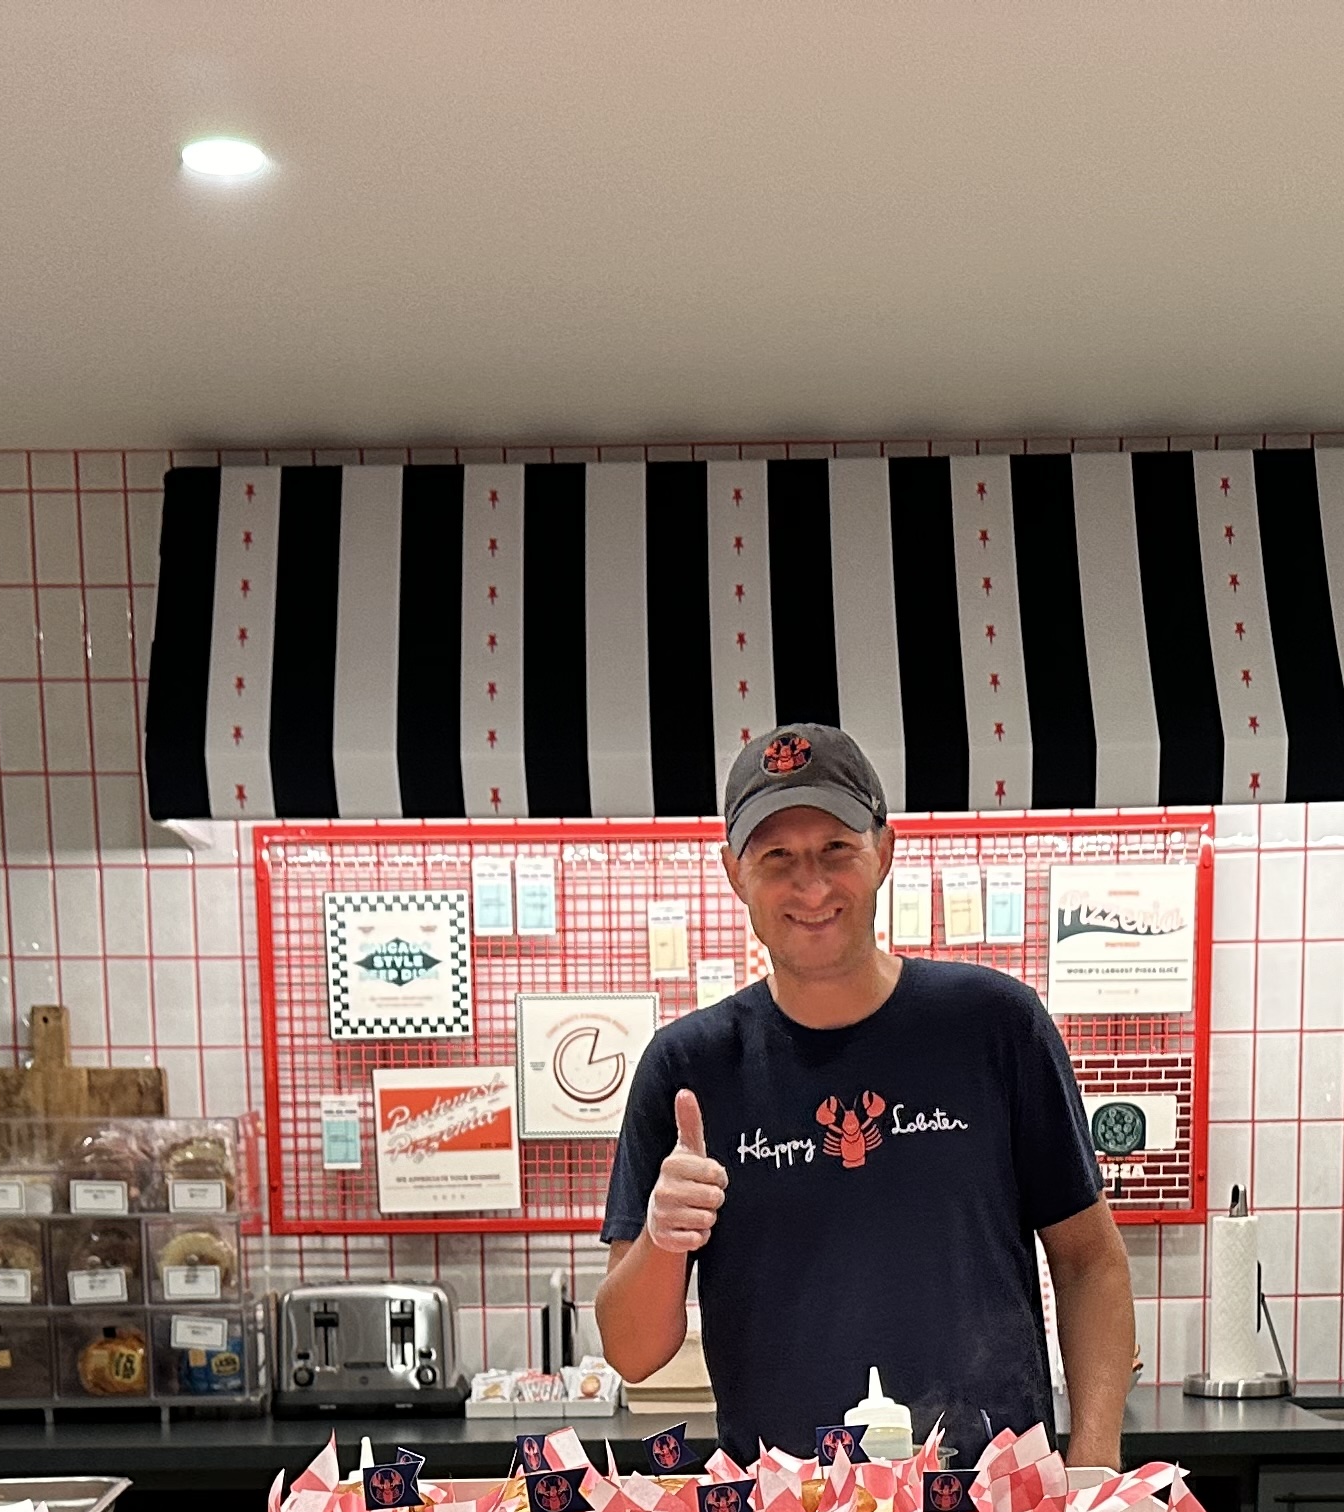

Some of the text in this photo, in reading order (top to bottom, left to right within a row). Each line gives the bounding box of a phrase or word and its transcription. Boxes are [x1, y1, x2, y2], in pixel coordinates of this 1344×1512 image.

[1059, 891, 1184, 934] Pizzeria
[373, 955, 424, 968] STYLE
[737, 1103, 968, 1169] Happy Lobster
